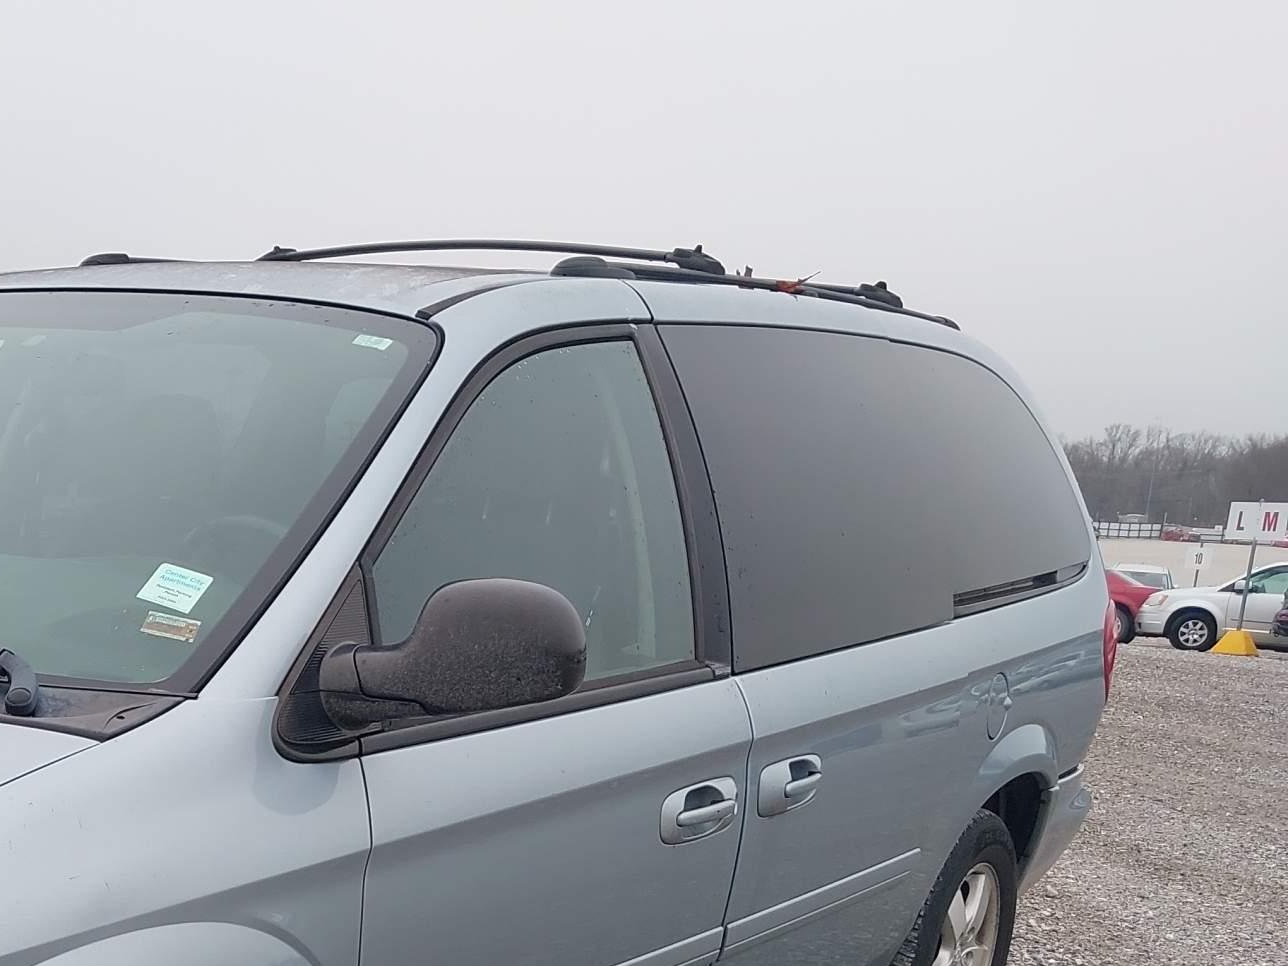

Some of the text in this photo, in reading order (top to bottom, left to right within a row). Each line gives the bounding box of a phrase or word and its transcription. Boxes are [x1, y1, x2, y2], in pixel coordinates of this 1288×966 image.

[1236, 511, 1245, 530] L
[1262, 511, 1279, 532] M
[1195, 552, 1203, 565] 10
